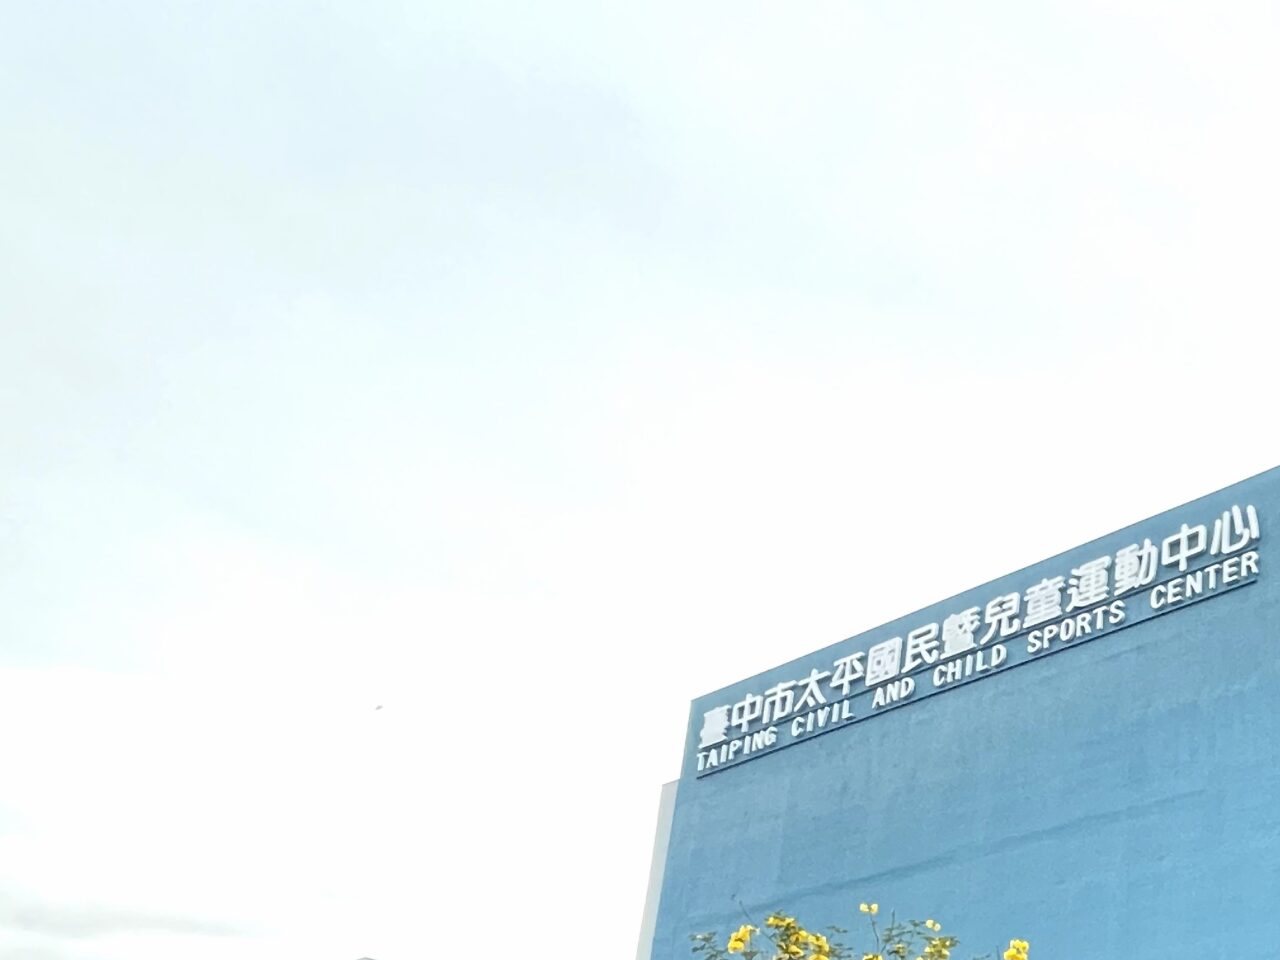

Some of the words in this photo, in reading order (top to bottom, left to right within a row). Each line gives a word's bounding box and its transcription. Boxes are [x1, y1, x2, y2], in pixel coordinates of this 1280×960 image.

[697, 727, 778, 771] TAIPING
[791, 700, 855, 736] CIVIL
[872, 677, 915, 709] AND
[933, 644, 1007, 687] CHILD
[1027, 600, 1126, 653] SPORTS
[1150, 551, 1260, 609] CENTER
